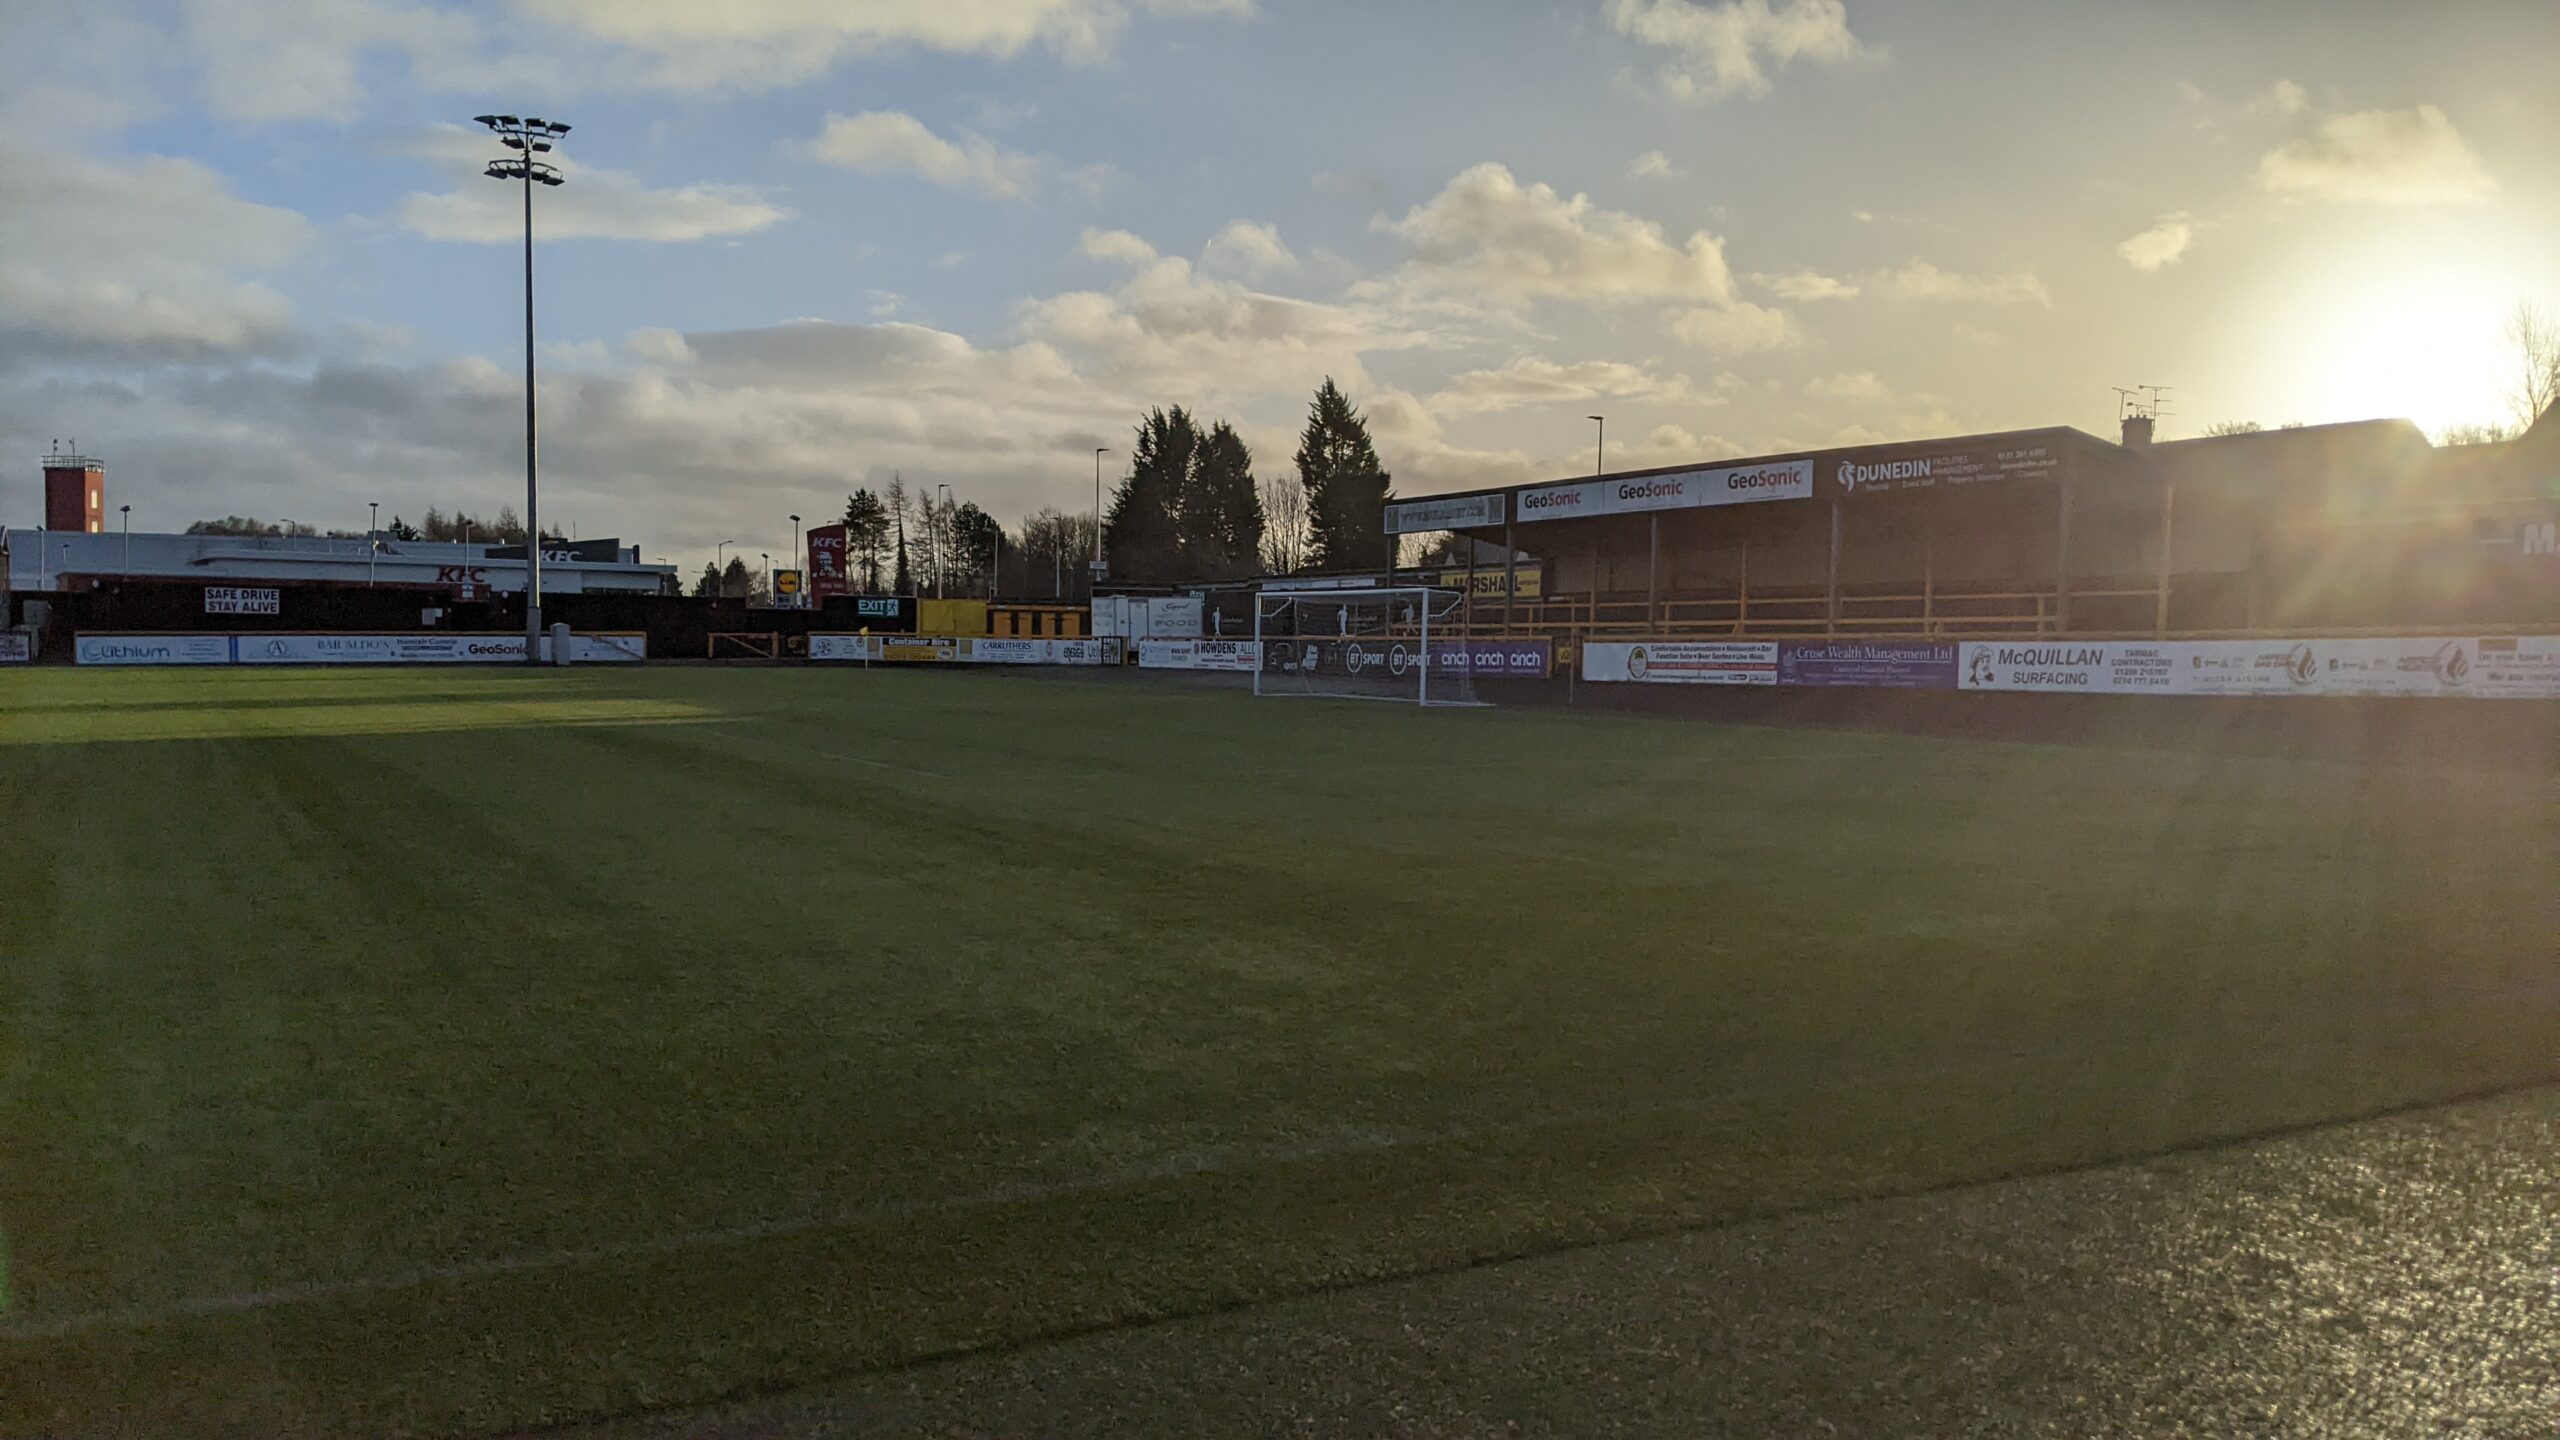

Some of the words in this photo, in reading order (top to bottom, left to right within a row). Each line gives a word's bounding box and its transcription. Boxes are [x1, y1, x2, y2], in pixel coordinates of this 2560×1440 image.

[1857, 459, 1931, 482] DUNEDIN
[1728, 466, 1802, 490] GeoSonic
[1619, 479, 1684, 500] GeoSonic
[1525, 491, 1581, 509] GeoSonic
[813, 537, 843, 548] KFC
[541, 550, 583, 563] KFC
[436, 567, 487, 582] KFC
[207, 588, 237, 600] SAFE
[242, 588, 278, 600] DRIVE
[208, 601, 239, 612] STAY
[243, 601, 278, 612] ALIVE
[858, 599, 886, 611] EXIT
[1155, 619, 1198, 627] FOOD
[468, 643, 529, 656] GeoSonic
[982, 640, 1032, 650] CARRUTHERS
[1200, 642, 1237, 655] HOWDENS
[1350, 653, 1360, 665] BT
[1362, 653, 1385, 666] SPORT
[1393, 653, 1403, 665] BT
[1407, 653, 1431, 666] SPOT
[1441, 652, 1470, 666] cinch
[1475, 651, 1504, 666] cinch
[1510, 650, 1541, 667] cinch
[1797, 647, 1825, 659] Cruse
[1827, 646, 1863, 659] Wealth
[1864, 646, 1932, 664] Management
[1934, 646, 1953, 660] Ltd
[1998, 648, 2104, 666] McQUILLAN
[2125, 649, 2160, 657] TARMAC
[2111, 659, 2173, 667] CONTRACTORS
[2012, 672, 2088, 685] SURFACING
